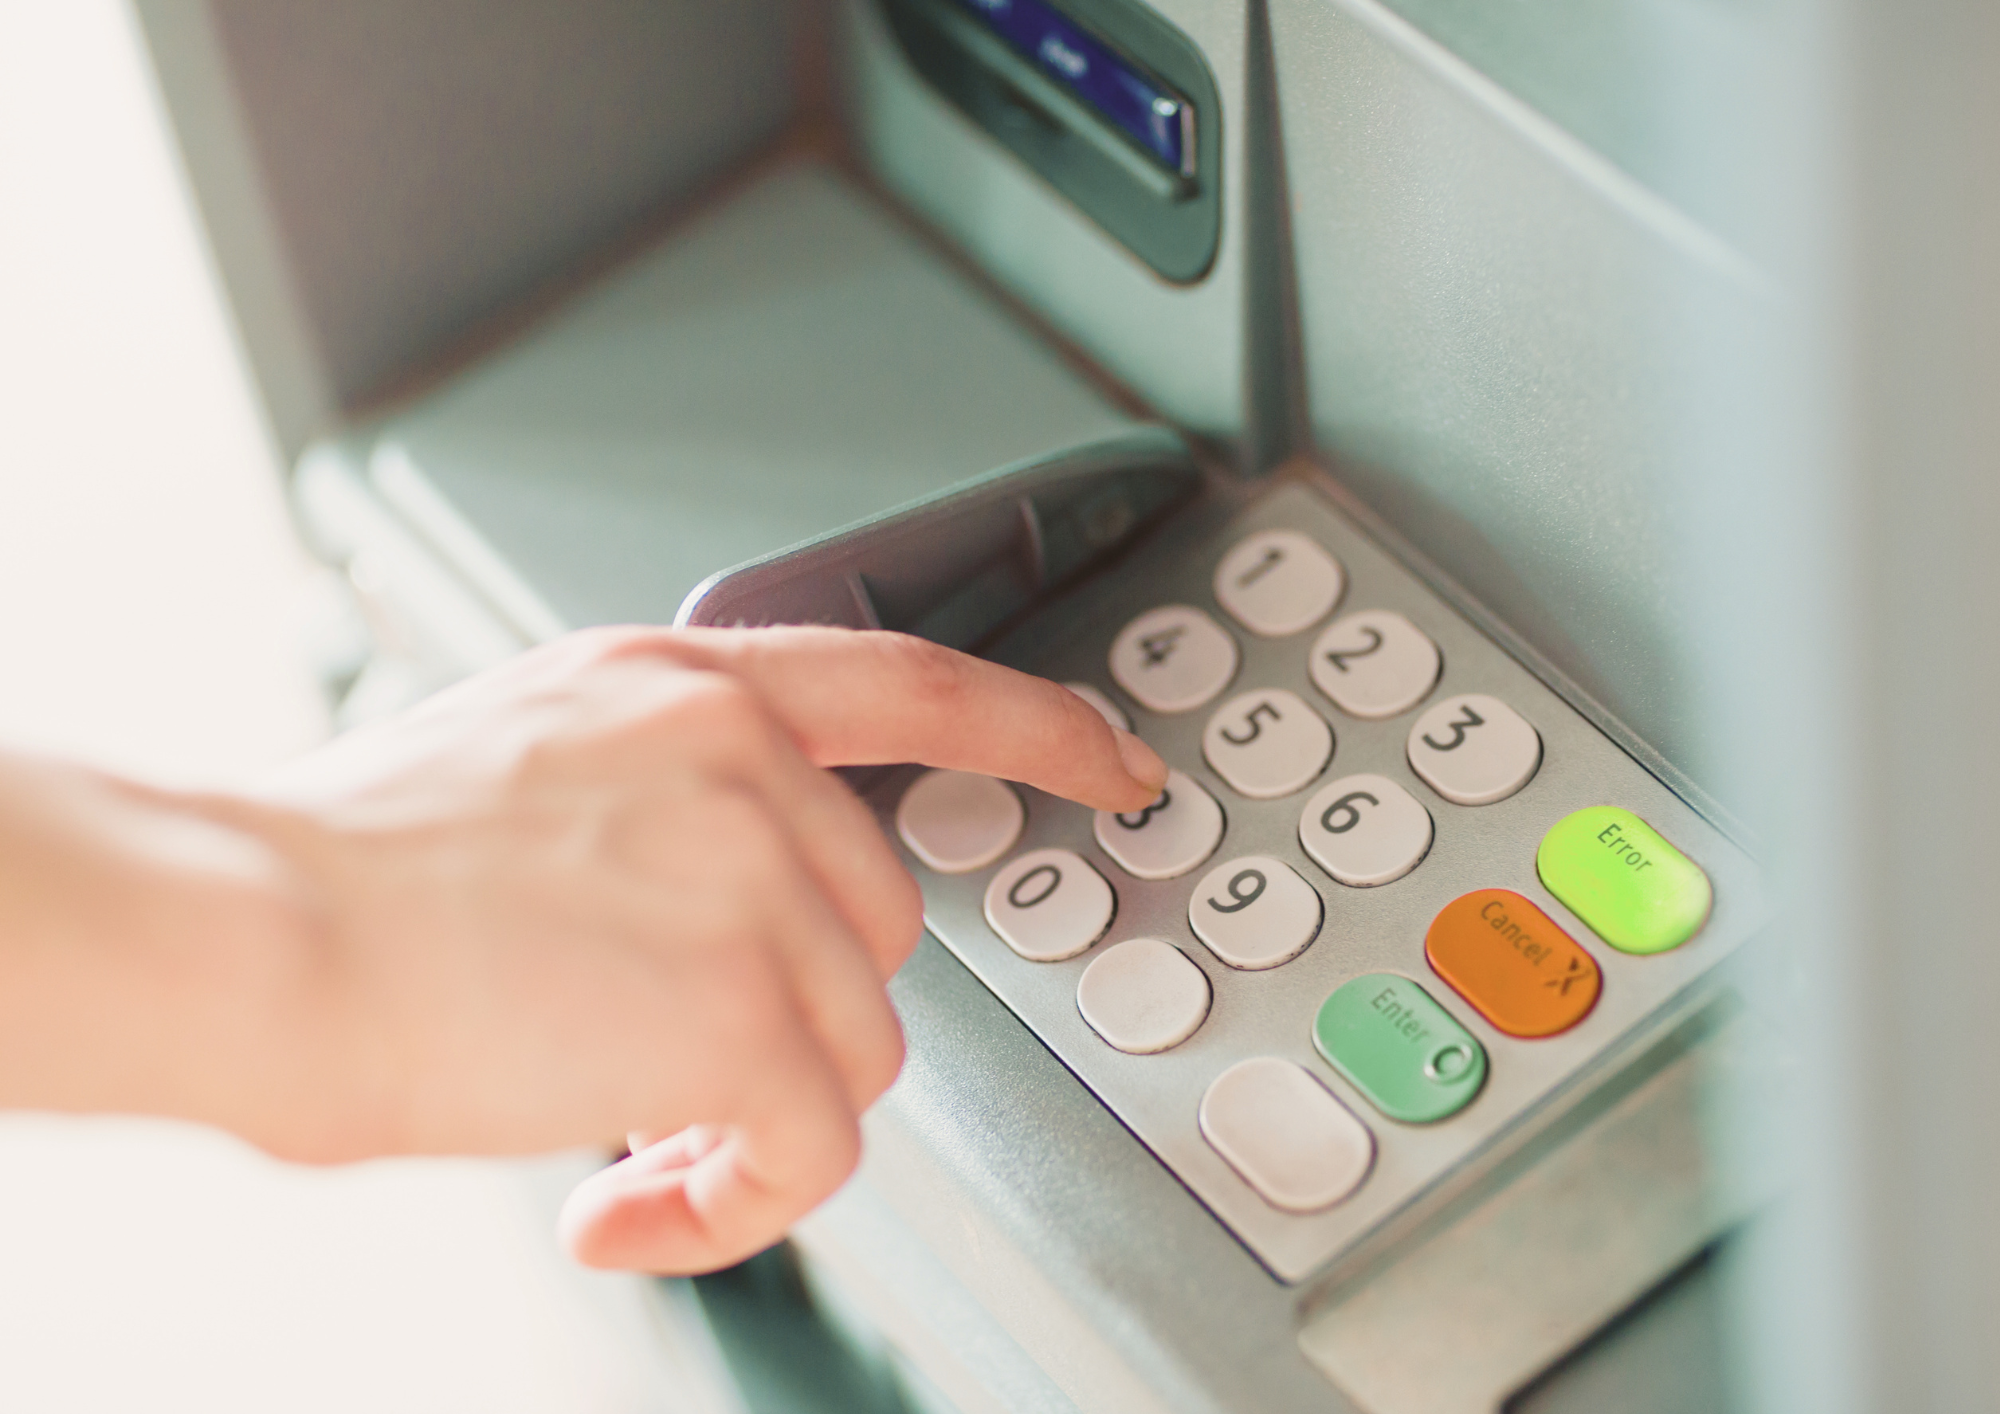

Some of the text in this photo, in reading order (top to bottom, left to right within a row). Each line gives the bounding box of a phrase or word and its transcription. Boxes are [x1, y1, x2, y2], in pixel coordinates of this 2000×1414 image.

[1237, 548, 1285, 588] 1
[1137, 625, 1187, 669] 4
[1326, 625, 1384, 673] 2
[1220, 702, 1281, 745] 5
[1421, 704, 1485, 752] 3
[1320, 791, 1379, 834] 6
[1596, 823, 1653, 871] Error
[1008, 865, 1062, 908] 0
[1207, 869, 1267, 913] 9
[1480, 901, 1552, 966] Cancel
[1371, 987, 1430, 1043] Enter
